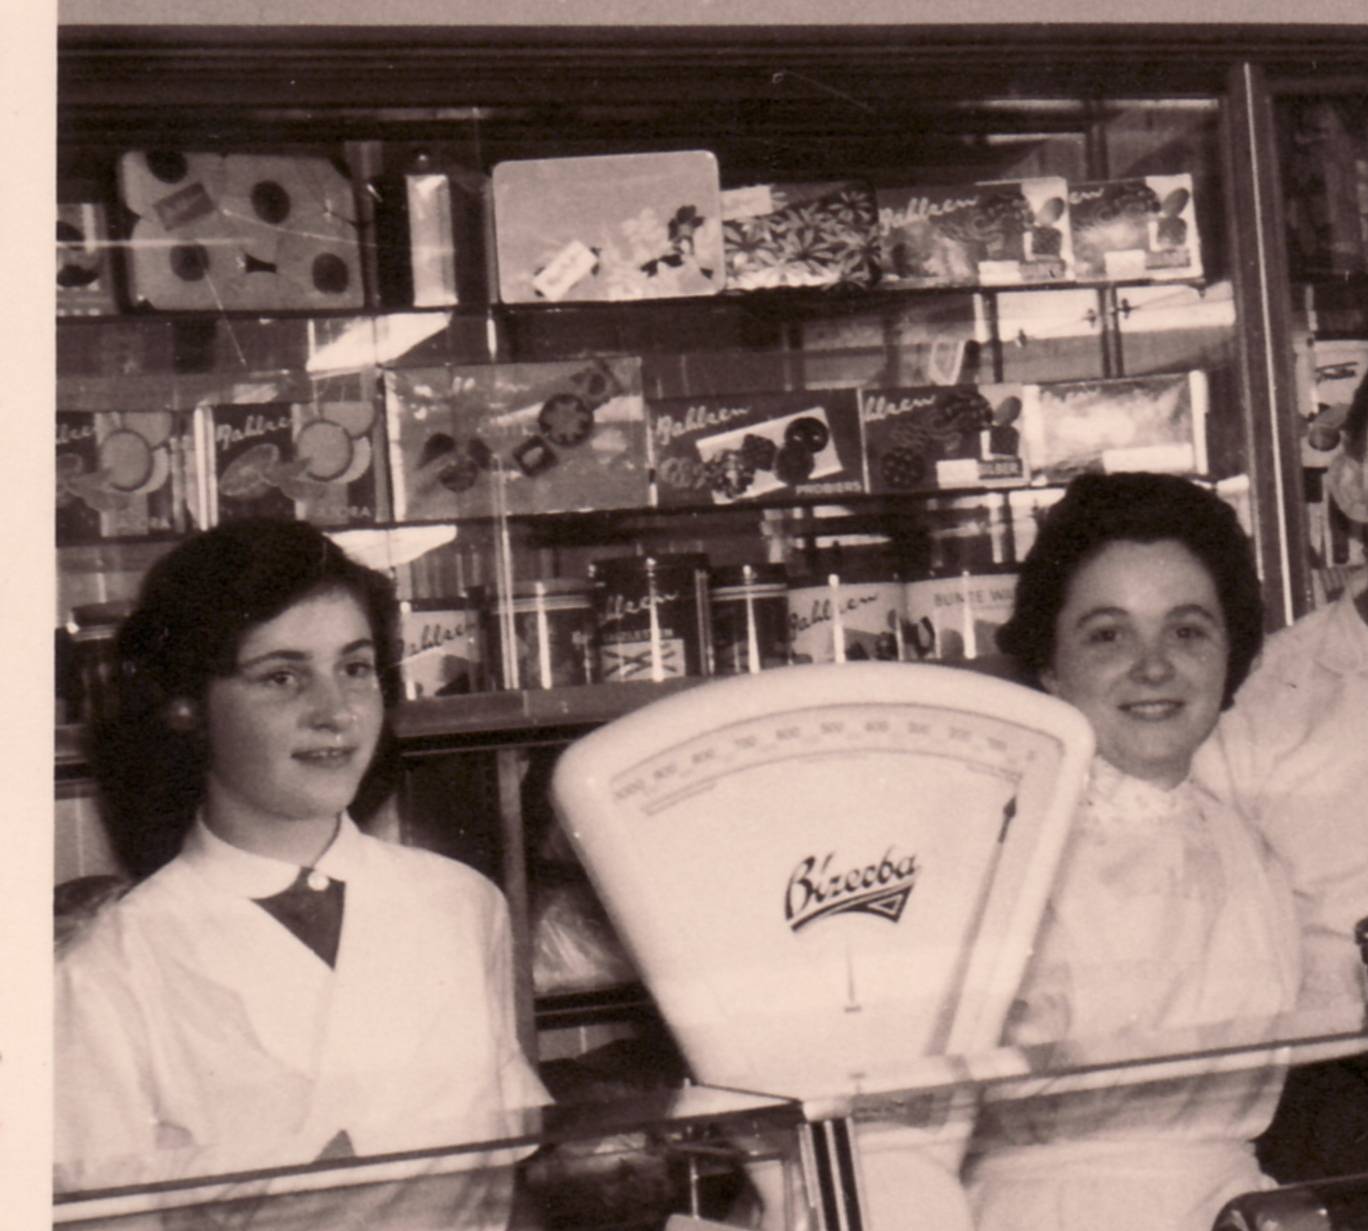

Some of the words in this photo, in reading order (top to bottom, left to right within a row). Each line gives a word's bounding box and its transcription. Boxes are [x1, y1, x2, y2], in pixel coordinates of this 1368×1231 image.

[877, 195, 980, 237] Bahlsen
[655, 404, 753, 446] Bahlsen
[863, 394, 936, 422] hlsen
[215, 414, 293, 450] Bahlse
